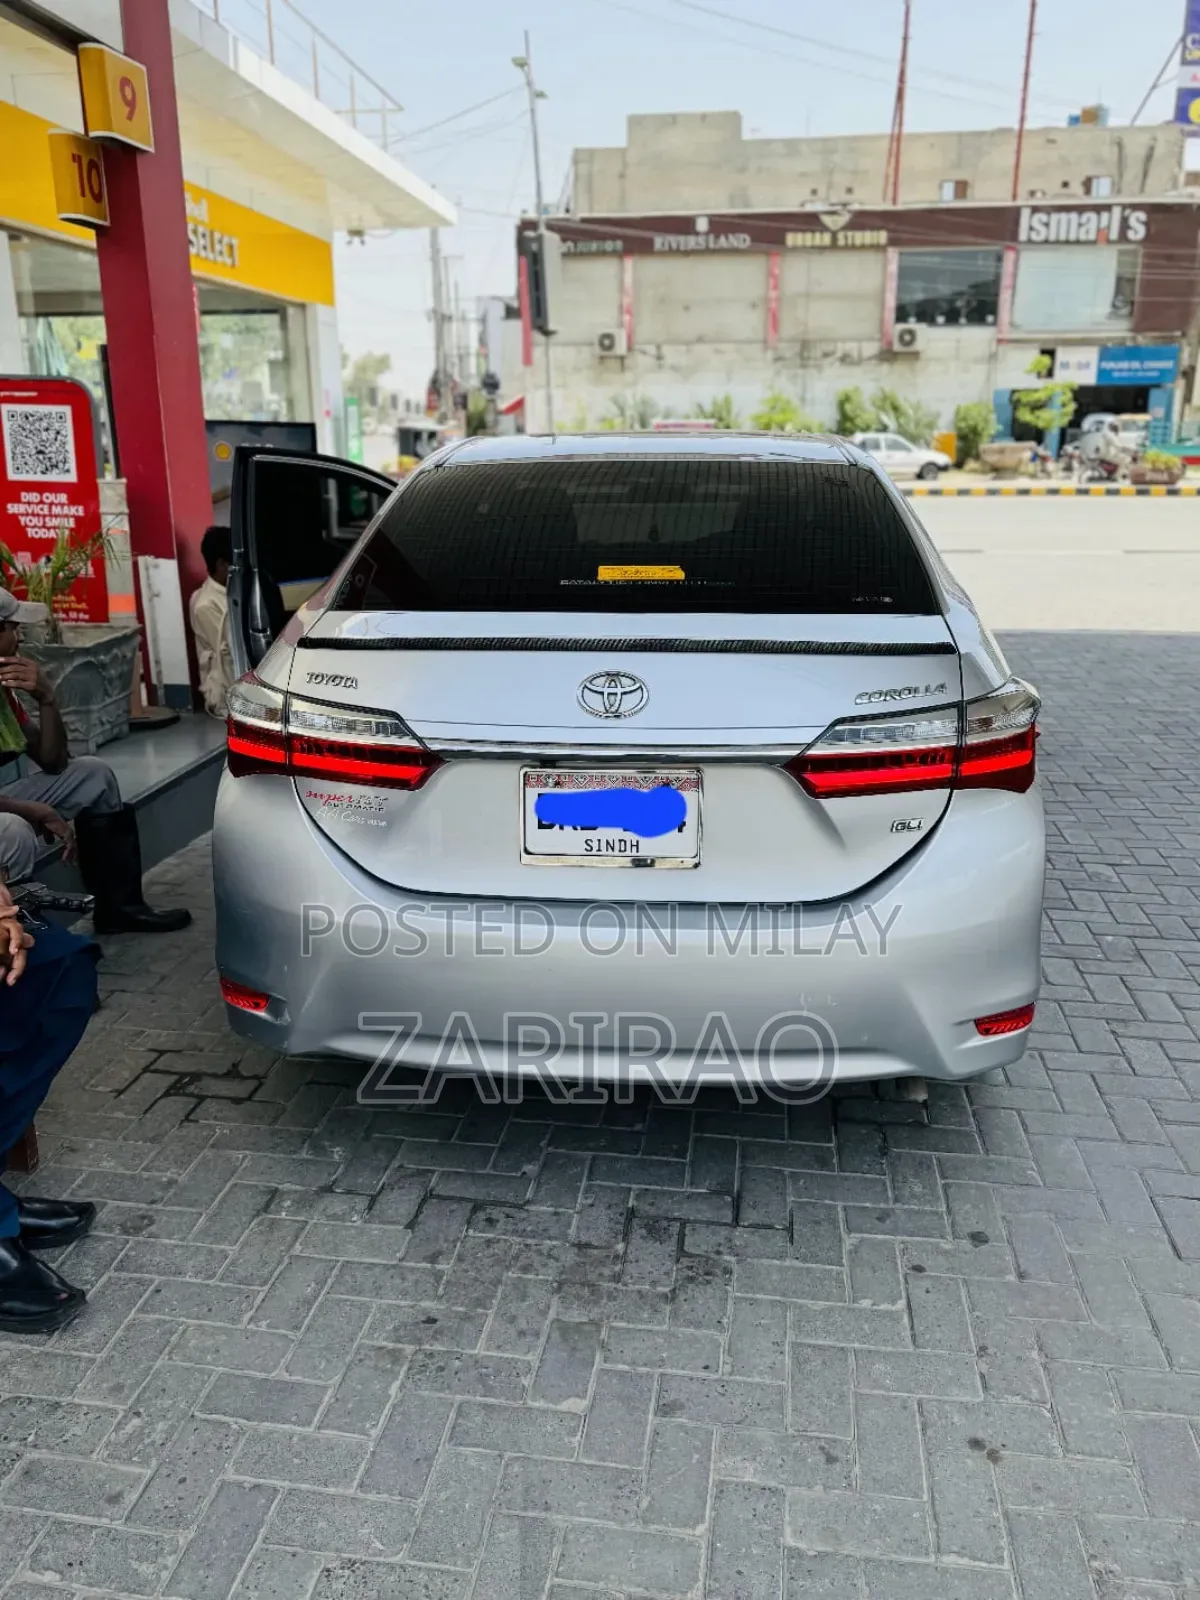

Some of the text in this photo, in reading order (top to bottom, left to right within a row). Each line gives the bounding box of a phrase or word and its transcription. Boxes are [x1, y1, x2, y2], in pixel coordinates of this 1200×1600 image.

[119, 76, 137, 122] 9
[71, 152, 104, 204] 10
[187, 223, 240, 268] SELECT
[706, 232, 751, 250] LAND
[20, 491, 68, 504] DID OUR
[7, 503, 84, 517] SERVICE MAKE
[18, 515, 76, 528] YOU SMILE
[306, 672, 358, 690] TOYOTA
[854, 682, 949, 706] COROLLA
[584, 838, 640, 854] SINDH
